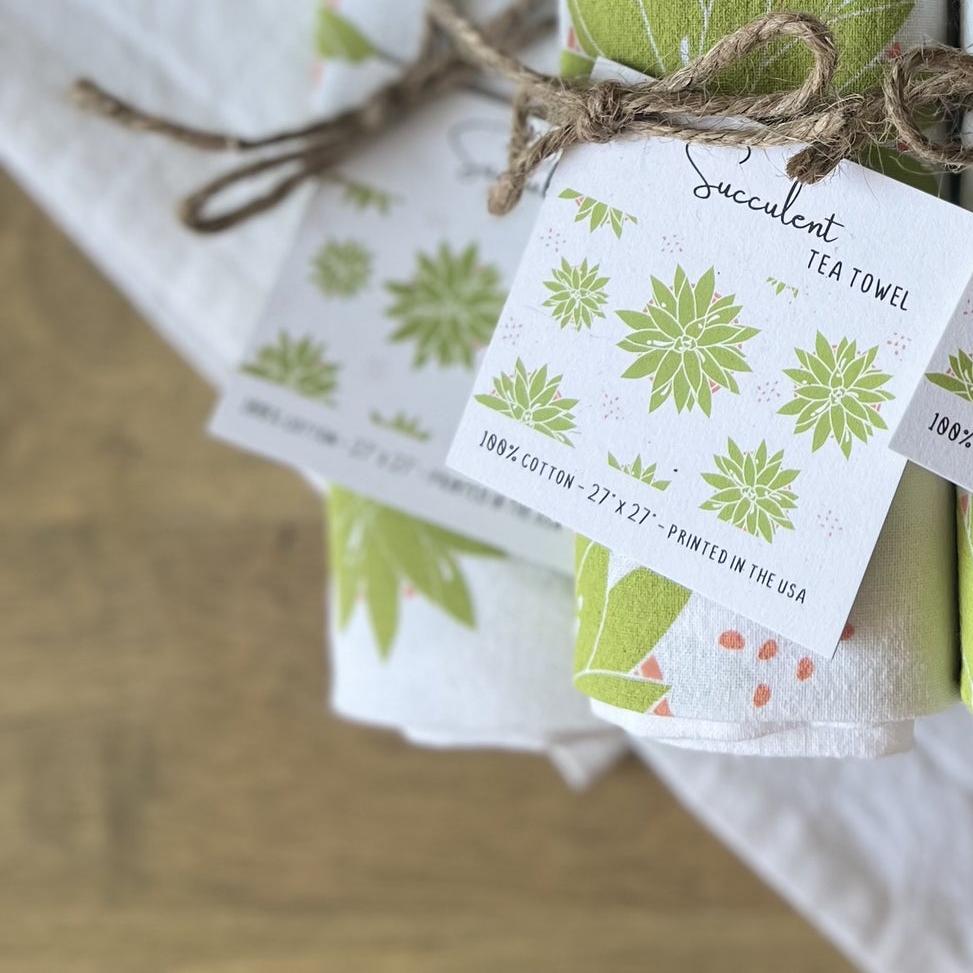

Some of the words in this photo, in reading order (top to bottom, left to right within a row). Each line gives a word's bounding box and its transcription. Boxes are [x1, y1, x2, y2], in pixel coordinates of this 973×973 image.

[686, 144, 845, 243] Succulent
[808, 249, 843, 282] TEA
[849, 267, 909, 311] TOWEL
[479, 430, 520, 463] 100%
[521, 453, 575, 490] COTTON
[667, 523, 728, 565] PRINTED
[729, 554, 747, 574] IN
[748, 563, 777, 589] THE
[777, 578, 807, 605] USA
